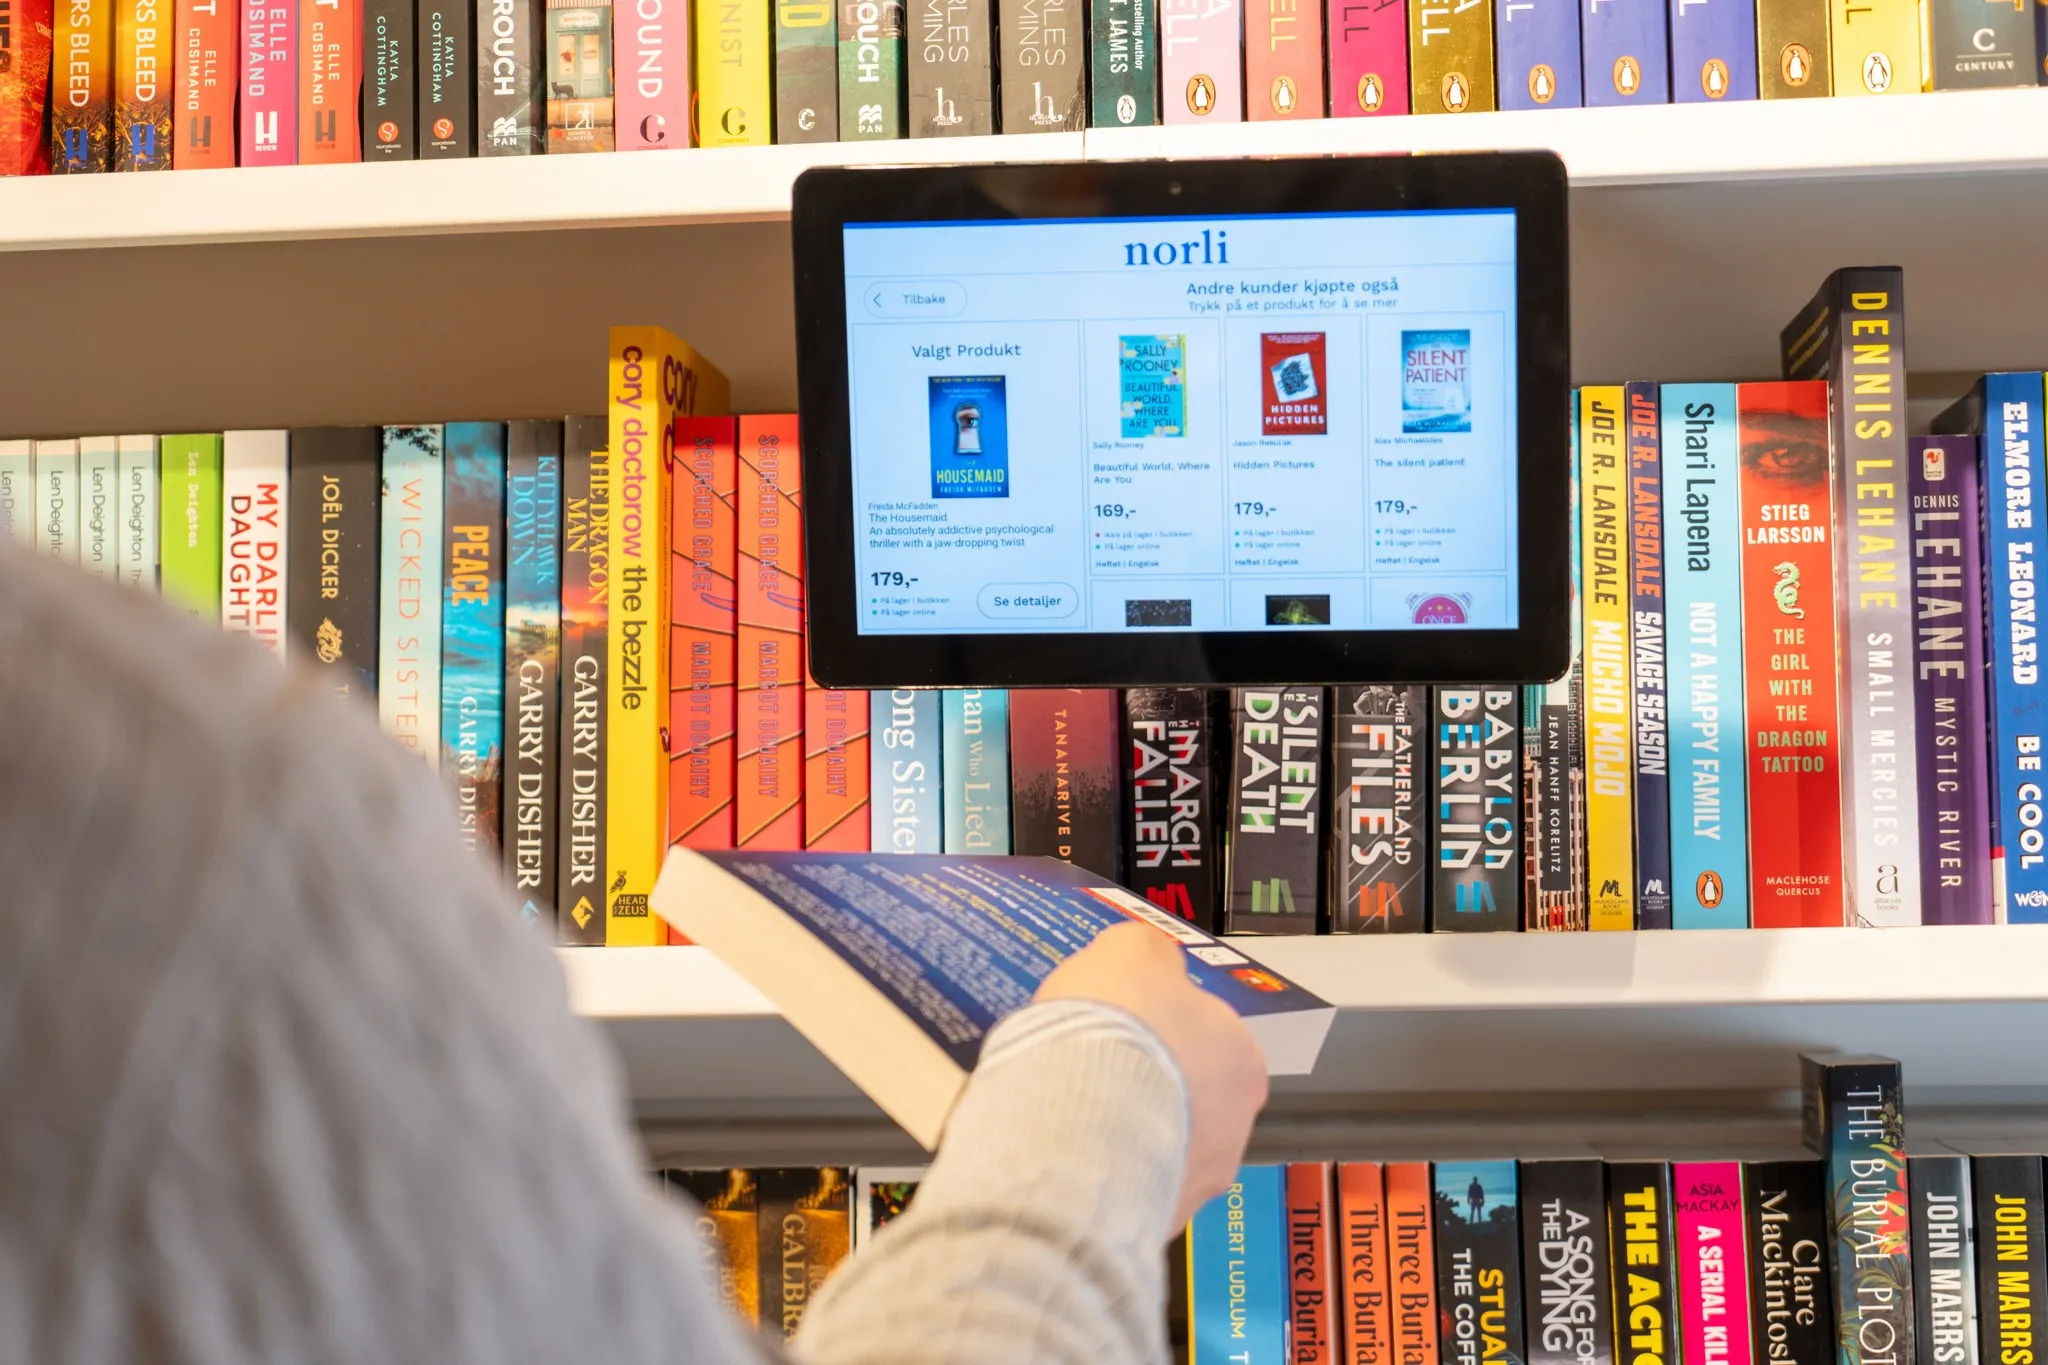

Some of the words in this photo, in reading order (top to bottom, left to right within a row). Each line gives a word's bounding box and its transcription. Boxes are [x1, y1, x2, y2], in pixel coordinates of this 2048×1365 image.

[69, 33, 90, 107] BLEED
[189, 28, 200, 110] COSIMANO
[204, 50, 216, 87] ELLE
[312, 22, 323, 105] COSIMANO
[328, 44, 340, 81] ELLE
[377, 16, 386, 107] COTTINGHAM
[389, 40, 398, 81] KAYLA
[432, 12, 441, 104] COTTINGHAM
[444, 37, 453, 78] KAYLA
[1110, 18, 1128, 73] JAMES
[1134, 39, 1143, 70] Author
[1955, 60, 2015, 72] CENTURY
[493, 137, 517, 146] PAN
[859, 124, 882, 133] PAN
[1125, 229, 1229, 265] norli
[903, 293, 946, 305] Tilbake
[1186, 281, 1235, 295] Andre
[1240, 281, 1298, 294] kunder
[1304, 279, 1355, 296] kjøpte
[1361, 277, 1399, 293] også
[1188, 301, 1221, 313] Trykk
[1264, 299, 1314, 313] produkt
[1319, 298, 1337, 309] for
[1373, 299, 1398, 308] mer
[616, 345, 643, 410] cory
[911, 345, 952, 360] Valgt
[957, 343, 1022, 357] Produkt
[1125, 360, 1178, 372] ROONEY
[1134, 344, 1167, 357] SALLY
[1406, 368, 1466, 383] PATIENT
[1407, 349, 1466, 366] SILENT
[1851, 292, 1894, 440] DENNIS
[1125, 382, 1179, 393] BEAUTIFUL
[1134, 406, 1169, 416] WHERE
[1271, 404, 1319, 413] HIDDEN
[1092, 441, 1112, 450] Sally
[1114, 441, 1144, 450] Rooney
[1128, 418, 1149, 428] ARE
[1152, 418, 1177, 427] YOU
[1265, 415, 1325, 425] PICTURES
[1591, 400, 1615, 446] JOE
[1684, 402, 1715, 469] Shari
[50, 470, 63, 497] Len
[92, 466, 105, 493] Len
[132, 465, 145, 492] Len
[188, 452, 198, 476] Len
[622, 418, 648, 558] doctorow
[693, 436, 713, 528] SCORCHED
[936, 469, 1005, 484] HOUSEMAID
[1093, 462, 1139, 472] Beautiful
[1178, 461, 1211, 470] Where
[1093, 475, 1111, 484] Are
[1114, 475, 1132, 484] You
[1233, 461, 1270, 470] Hidden
[1273, 460, 1315, 469] Pictures
[1374, 458, 1393, 467] The
[1397, 458, 1426, 467] silent
[1428, 458, 1465, 468] patient
[2002, 401, 2032, 529] ELMORE
[188, 483, 199, 548] Deighton
[257, 483, 279, 528] MY
[322, 475, 343, 523] JOËL
[512, 475, 536, 566] DOWN
[537, 455, 557, 585] KITTYHAWK
[567, 497, 587, 553] MAN
[868, 502, 894, 511] Freida
[896, 502, 939, 510] McFadden
[869, 513, 888, 522] The
[890, 512, 947, 522] Housemaid
[1094, 503, 1136, 519] 169,-
[1233, 502, 1276, 517] 179,-
[1374, 499, 1417, 515] 179,-
[1680, 479, 1716, 572] Lapena
[1760, 503, 1810, 522] STIEG
[1913, 495, 1959, 508] DENNIS
[89, 494, 106, 562] Deighton
[399, 479, 422, 620] WICKED
[869, 526, 883, 535] An
[885, 525, 935, 537] absolutely
[938, 524, 983, 534] addictive
[985, 524, 1054, 536] psychological
[869, 538, 900, 548] thriller
[902, 538, 924, 547] with
[1001, 537, 1025, 547] twist
[1592, 485, 1617, 606] LANSDALE
[1747, 526, 1825, 545] LARSSON
[1855, 459, 1898, 609] LEHANE
[321, 529, 339, 599] DICKER
[452, 525, 490, 606] PEACE
[622, 565, 648, 612] the
[692, 535, 712, 591] GRACE
[870, 571, 918, 588] 179,-
[993, 596, 1010, 606] Se
[1013, 595, 1062, 608] detaljer
[1914, 512, 1965, 680] LEHANE
[2008, 542, 2039, 685] LEONARD
[1635, 611, 1665, 690] SAVAGE
[1689, 602, 1717, 647] NOT
[1773, 628, 1805, 645] THE
[622, 620, 648, 710] bezzle
[691, 641, 711, 714] MARGOT
[1591, 620, 1624, 714] MUCHO
[1769, 679, 1812, 696] WITH
[1771, 654, 1810, 671] GIRL
[1867, 633, 1895, 718] SMALL
[460, 695, 478, 776] GARRY
[518, 659, 544, 766] GARRY
[573, 655, 598, 763] GARRY
[1395, 701, 1405, 724] THE
[1548, 715, 1559, 750] JEAN
[1637, 694, 1666, 775] SEASON
[1690, 674, 1720, 753] HAPPY
[1775, 705, 1807, 722] THE
[690, 720, 710, 798] DOUAIHY
[1240, 692, 1280, 834] DEATH
[1593, 722, 1626, 796] MOJO
[1757, 730, 1827, 748] DRAGON
[1762, 756, 1825, 773] TATTOO
[1934, 698, 1959, 793] MYSTIC
[2016, 735, 2042, 771] BE
[1054, 709, 1071, 836] TANANARIVE
[1133, 721, 1170, 868] FALLEN
[1168, 730, 1202, 867] MARCH
[1351, 724, 1394, 866] FILES
[1394, 725, 1412, 865] FATHERLAND
[1440, 690, 1482, 869] BERLIN
[1484, 690, 1515, 870] BABYLON
[1549, 757, 1560, 802] HANFF
[1692, 759, 1721, 841] FAMILY
[1870, 730, 1898, 847] MERCIES
[517, 772, 543, 890] DISHER
[571, 768, 597, 887] DISHER
[964, 782, 991, 849] Lied
[1549, 808, 1561, 872] KORELITZ
[2017, 782, 2045, 870] COOL
[1938, 811, 1963, 887] RIVER
[618, 896, 645, 905] HEAD
[1766, 875, 1830, 885] MACLEHOSE
[1776, 887, 1821, 896] QUERCUS
[618, 905, 645, 915] ZEUS
[1676, 1200, 1740, 1213] MACKAY
[1689, 1182, 1724, 1196] ASIA
[1850, 1158, 1892, 1269] BURIAL
[1227, 1183, 1245, 1255] ROBERT
[1292, 1202, 1322, 1282] Three
[1623, 1186, 1659, 1266] THE
[1926, 1191, 1961, 1259] JOHN
[1994, 1194, 2029, 1261] JOHN
[1228, 1260, 1247, 1339] LUDLUM
[1539, 1241, 1574, 1351] DYING
[1568, 1236, 1596, 1324] SONG
[1698, 1245, 1727, 1322] SERIAL
[1792, 1239, 1821, 1326] Clare
[1929, 1268, 1965, 1362] MARRS
[1998, 1271, 2034, 1365] MARRS
